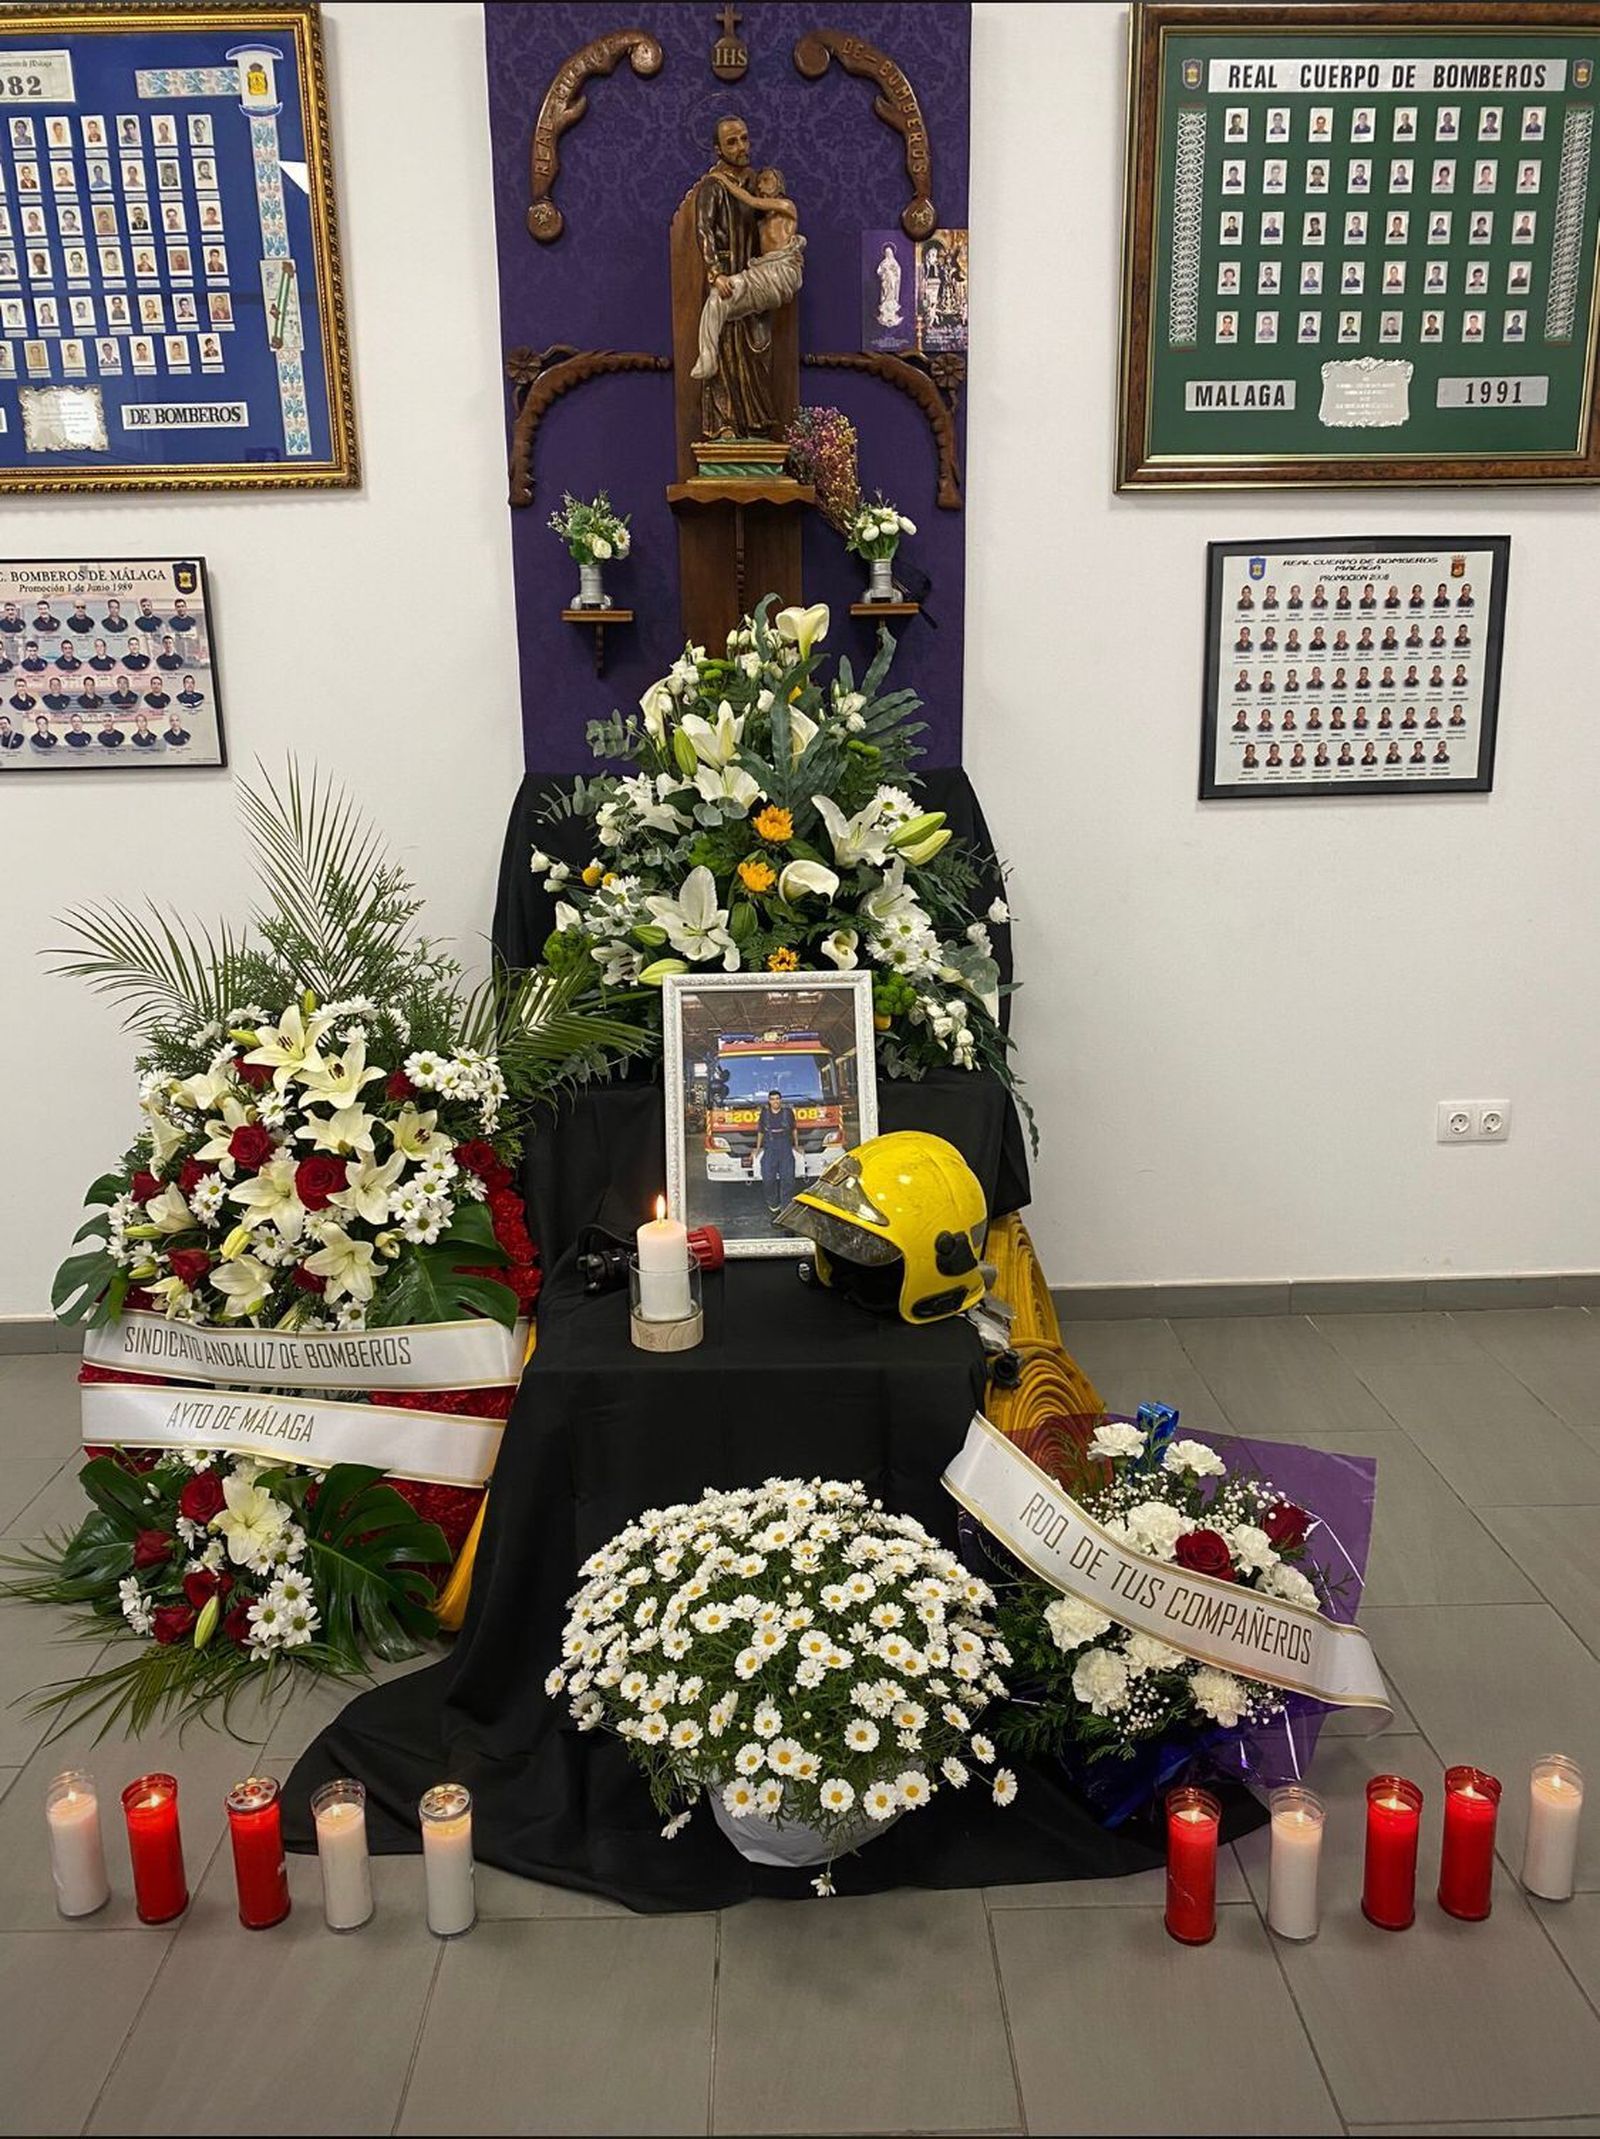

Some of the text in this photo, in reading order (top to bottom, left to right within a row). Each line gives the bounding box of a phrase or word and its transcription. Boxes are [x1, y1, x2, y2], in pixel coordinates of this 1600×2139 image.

[0, 75, 42, 96] 82
[1228, 63, 1547, 88] REAL CUERPO DE BOMBEROS
[1195, 384, 1286, 408] MALAGA
[1464, 380, 1523, 405] 1991
[130, 406, 241, 424] DE BOMBEROS
[11, 570, 86, 582] BOMBEROS
[89, 570, 107, 581] DE
[110, 566, 167, 581] MÁLAGA
[19, 583, 65, 593] Promoción
[74, 583, 84, 592] de
[86, 583, 110, 592] Junio
[124, 1326, 411, 1370] SINDICATO ANDALUZ DE BOMBEROS
[166, 1402, 315, 1443] AYTO DE MÁLAGA
[1018, 1491, 1313, 1666] RDO. DE TUS COMPAÑEROS
